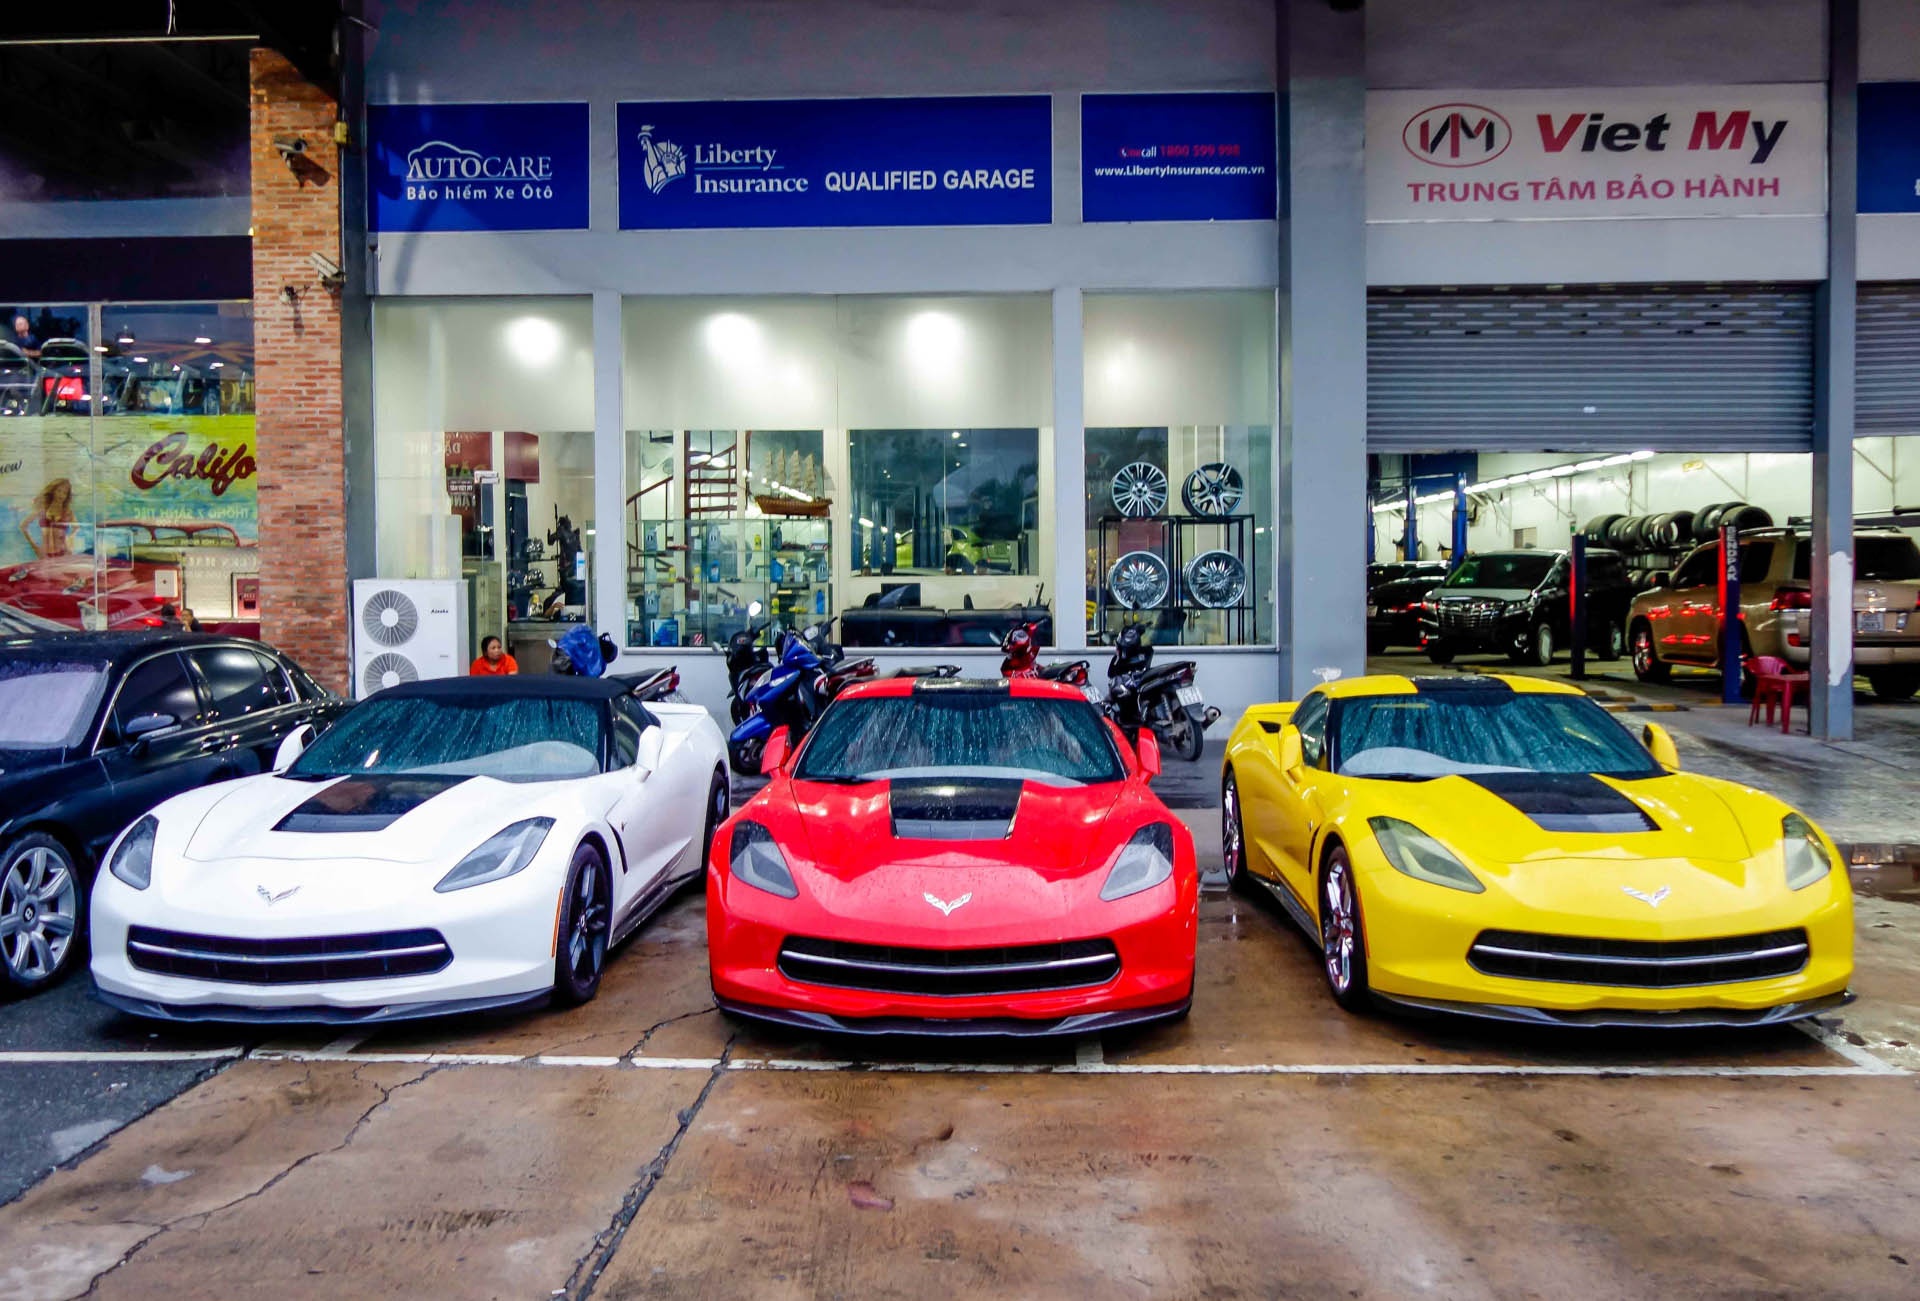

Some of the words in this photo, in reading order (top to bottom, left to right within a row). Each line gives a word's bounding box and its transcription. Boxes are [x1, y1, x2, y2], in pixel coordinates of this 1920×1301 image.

[1536, 113, 1671, 153] Viet
[1687, 111, 1788, 164] My
[406, 156, 552, 181] AUTOCARE
[694, 143, 777, 172] Liberty
[825, 170, 937, 192] QUALIFIED
[943, 168, 1035, 189] GARAGE
[1094, 164, 1265, 178] www.LibertyInsurance.com.vn
[407, 185, 438, 200] Bảo
[495, 185, 514, 200] Xe
[522, 183, 553, 200] Ôtô
[694, 173, 809, 194] Insurance
[1407, 182, 1520, 203] TRUNG
[1527, 177, 1596, 201] TÂM
[1606, 173, 1675, 200] BẢO
[1684, 173, 1781, 198] HÀNH
